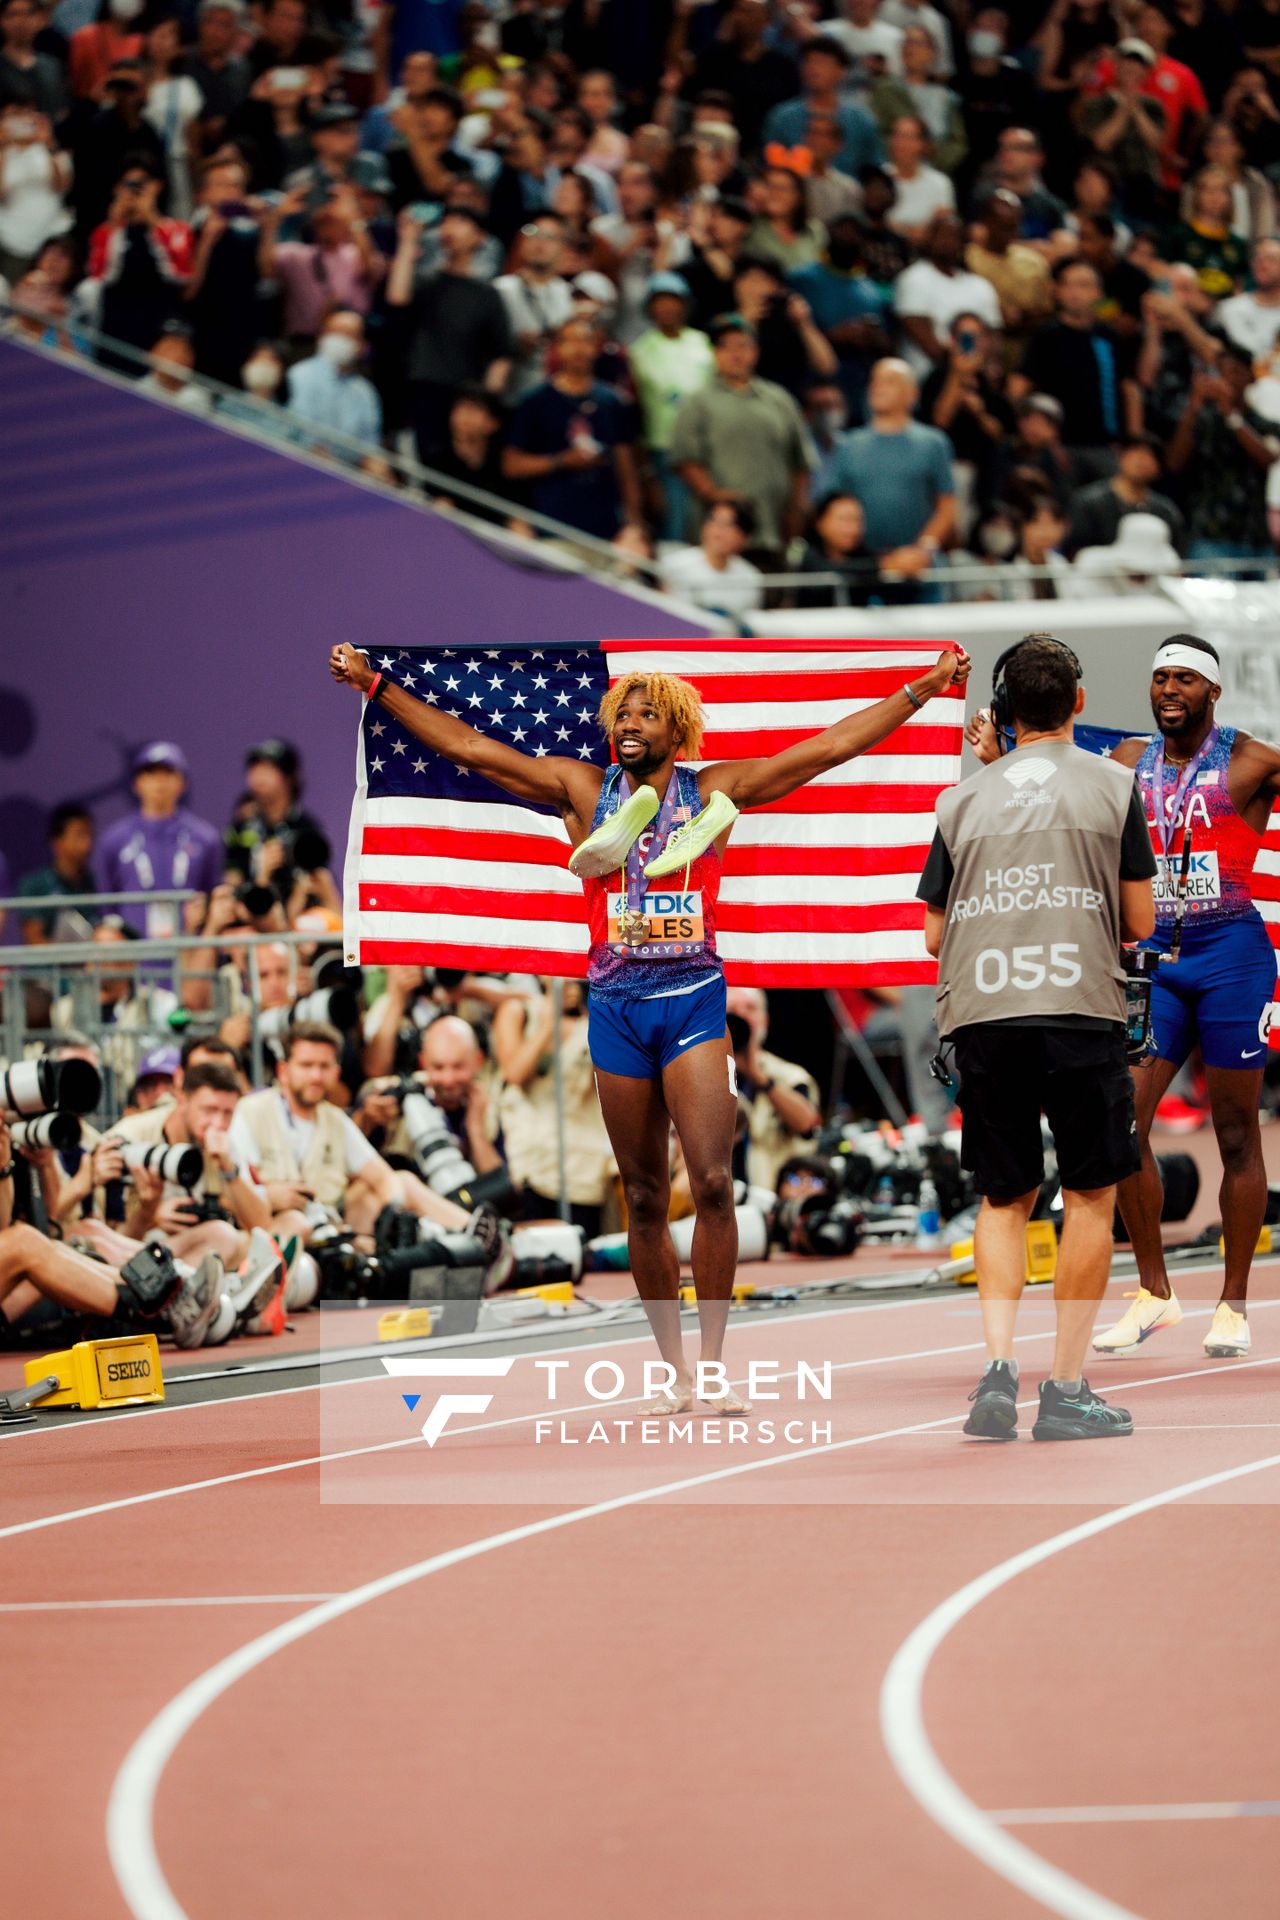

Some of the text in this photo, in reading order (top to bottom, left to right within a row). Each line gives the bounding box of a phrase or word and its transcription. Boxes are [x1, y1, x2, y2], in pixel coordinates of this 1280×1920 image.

[985, 863, 1055, 890] HOST
[640, 895, 695, 914] TDK
[649, 918, 694, 938] LES
[975, 943, 1082, 994] 055
[108, 1359, 150, 1382] SEIKO
